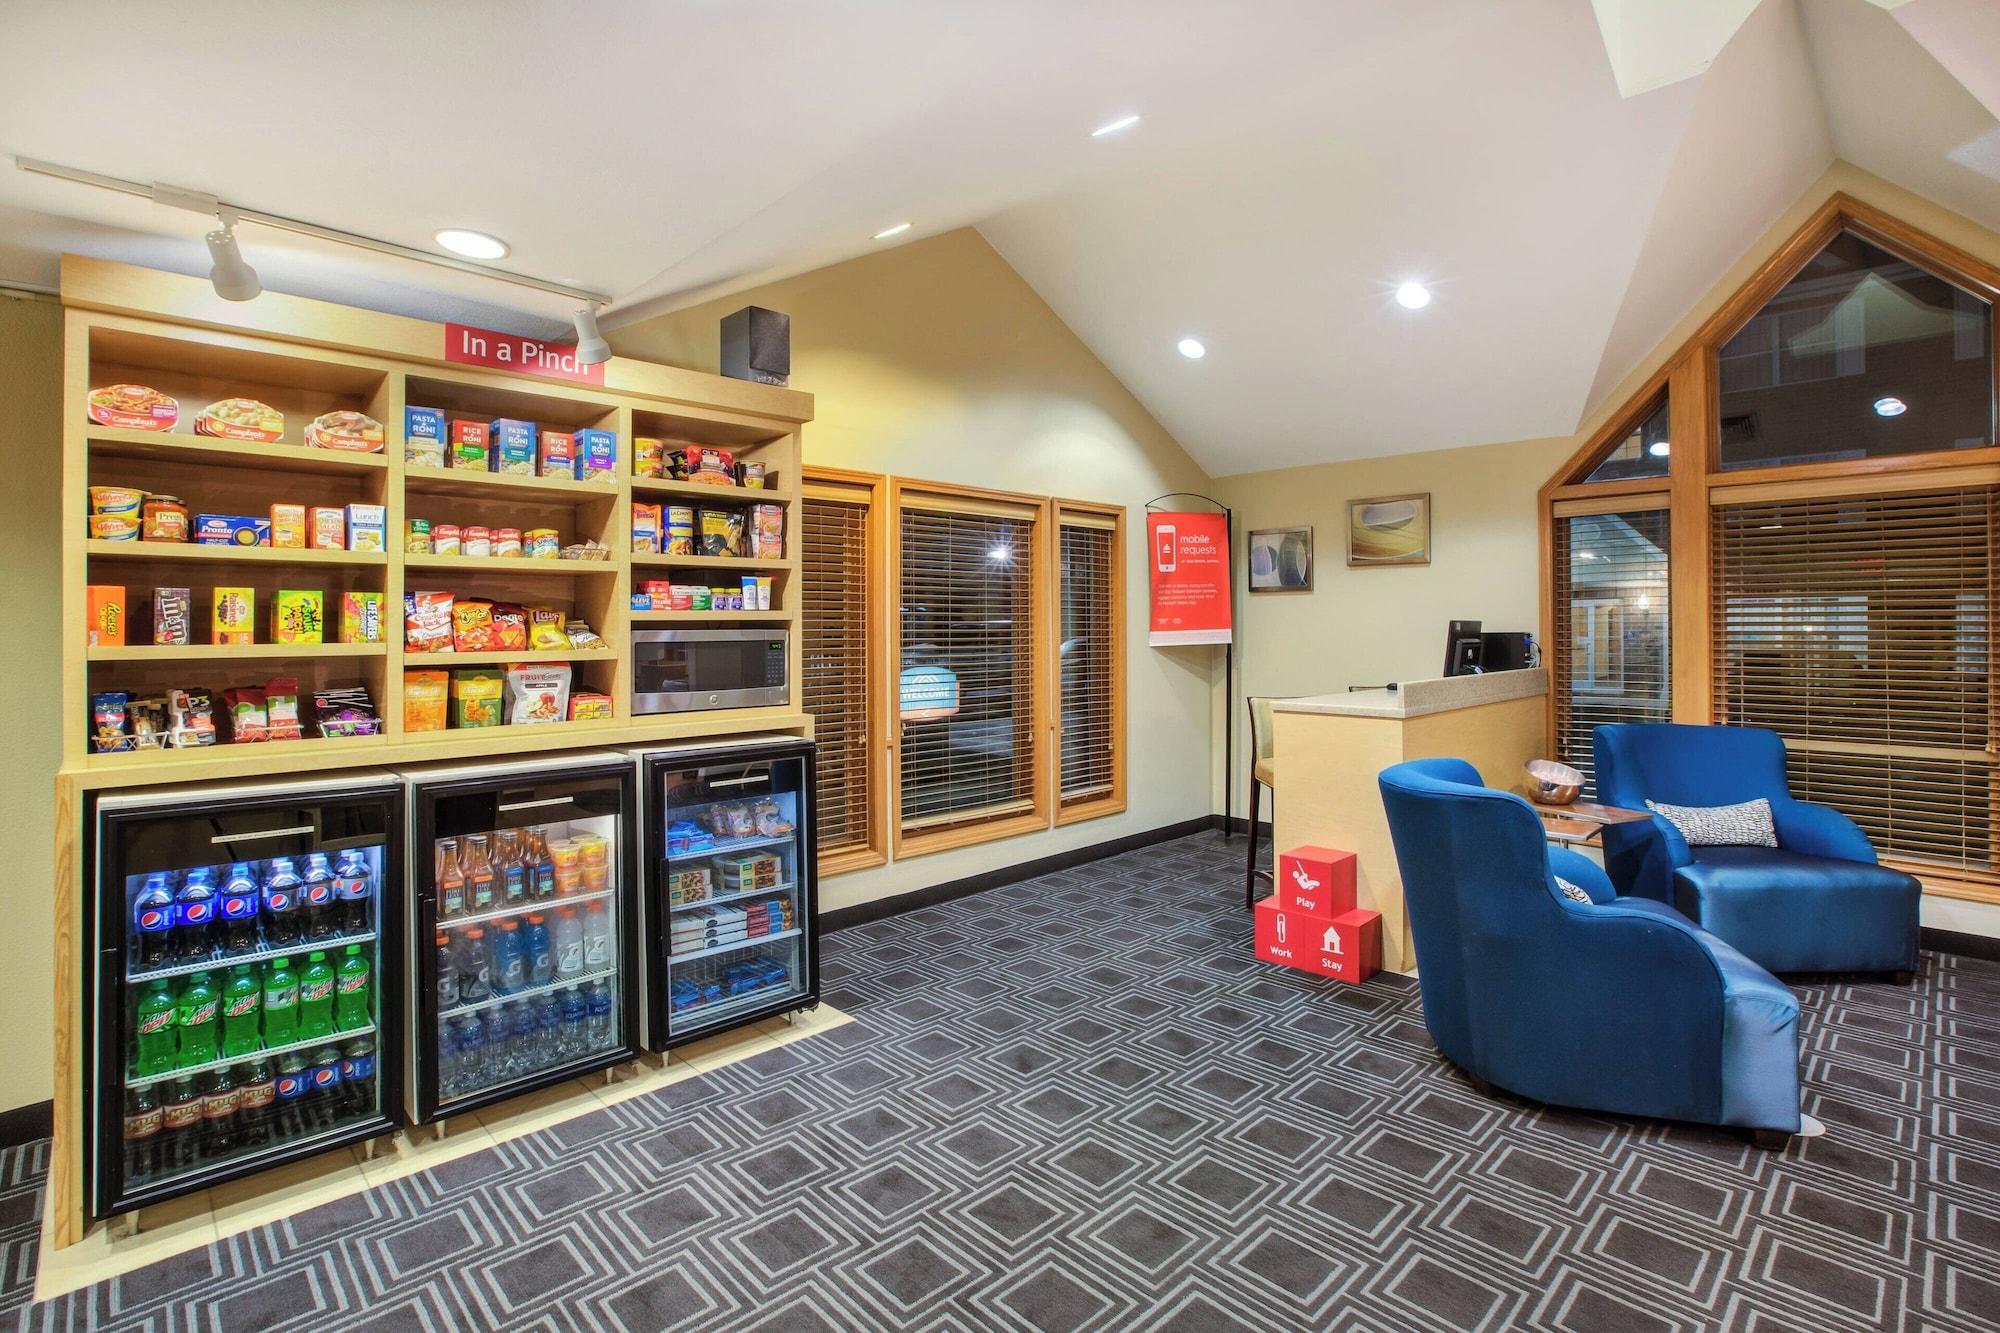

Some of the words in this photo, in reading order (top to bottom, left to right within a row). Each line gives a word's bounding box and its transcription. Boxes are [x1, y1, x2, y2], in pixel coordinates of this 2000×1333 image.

[463, 330, 487, 357] In
[496, 343, 512, 362] a
[412, 414, 436, 423] PASTA
[412, 425, 436, 434] RONI
[507, 427, 528, 435] PASTA
[463, 435, 482, 443] RONI
[508, 437, 528, 445] RONI
[551, 438, 567, 446] RICE
[551, 446, 568, 454] RONI
[592, 445, 610, 454] RONI
[201, 525, 233, 534] Pronto
[1180, 534, 1210, 543] mobile
[1180, 545, 1217, 556] requests
[302, 606, 313, 633] SOUR
[901, 687, 950, 699] WELCOME
[189, 695, 210, 707] P3
[1296, 897, 1315, 910] Play
[1270, 945, 1293, 959] Work
[1321, 958, 1343, 972] Stay
[242, 1087, 273, 1102] MUG
[208, 1094, 239, 1109] MUG
[170, 1104, 201, 1119] MUG
[130, 1114, 161, 1130] MUG
